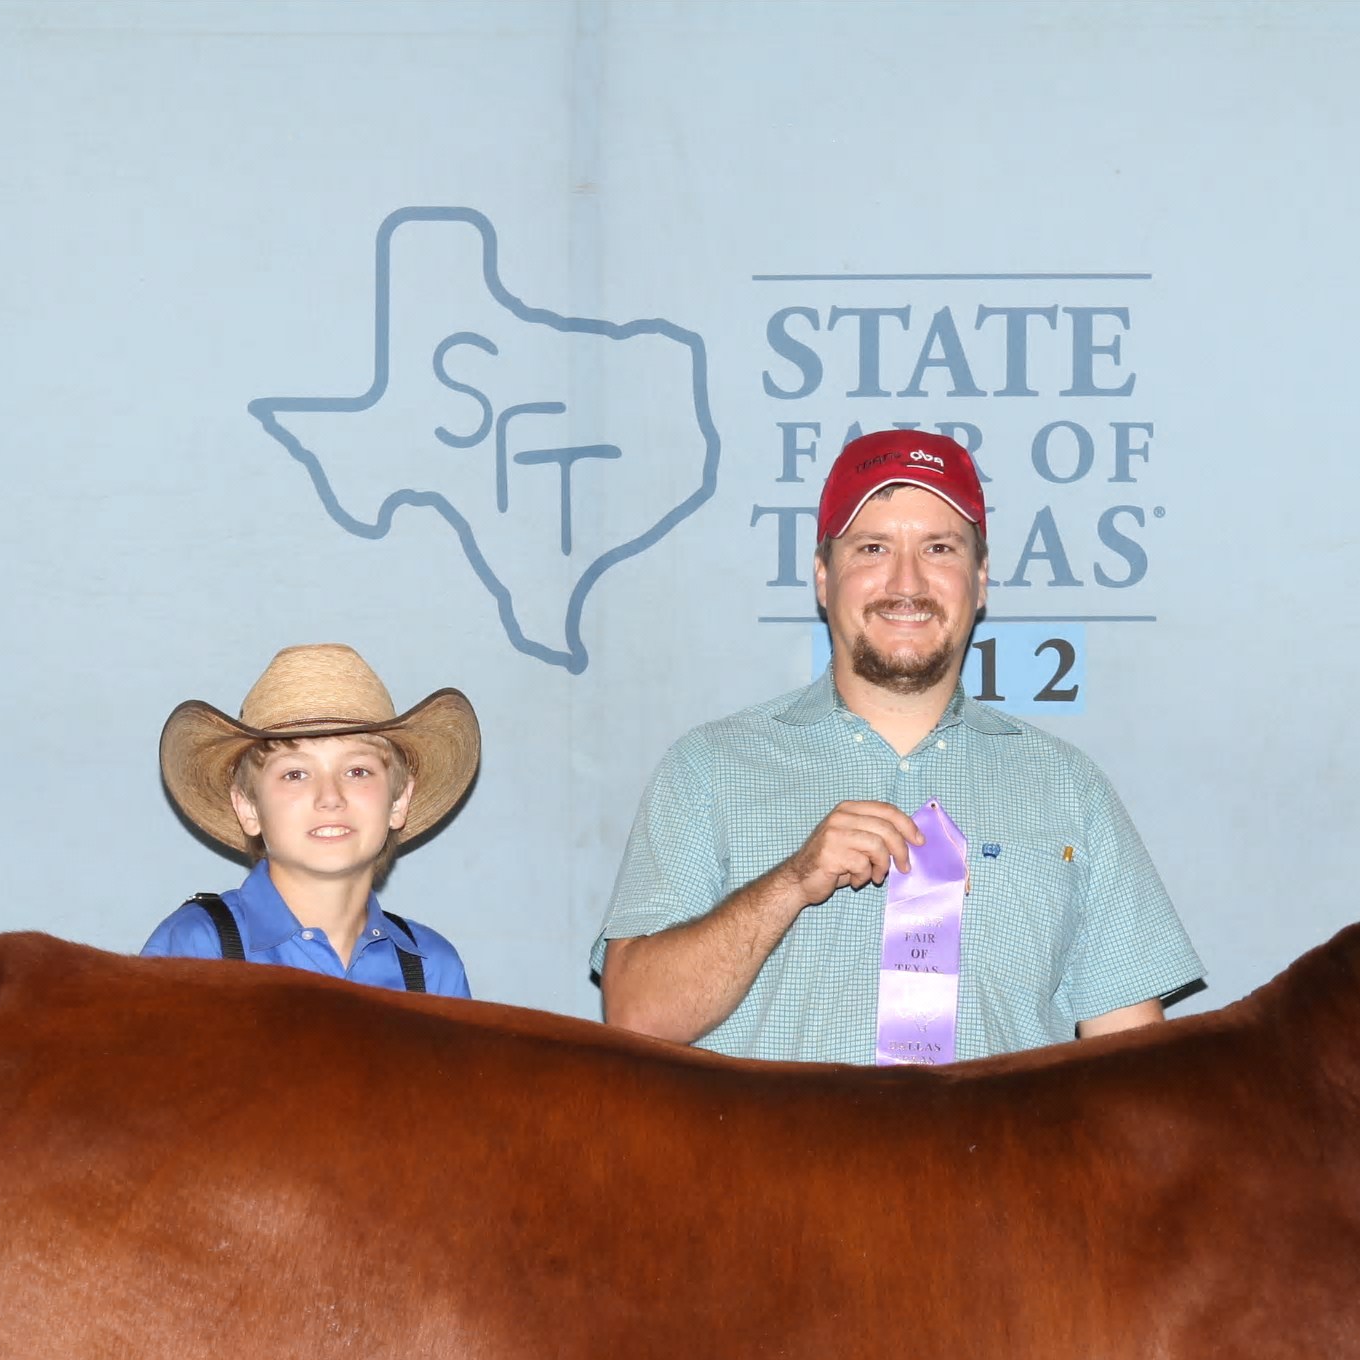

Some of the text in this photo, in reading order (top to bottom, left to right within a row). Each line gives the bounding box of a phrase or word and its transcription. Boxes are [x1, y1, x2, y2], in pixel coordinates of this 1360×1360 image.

[761, 303, 1137, 400] STATE
[775, 420, 1154, 484] FR OF
[972, 637, 1080, 702] 12
[904, 932, 936, 944] FAIR
[910, 948, 929, 960] OF
